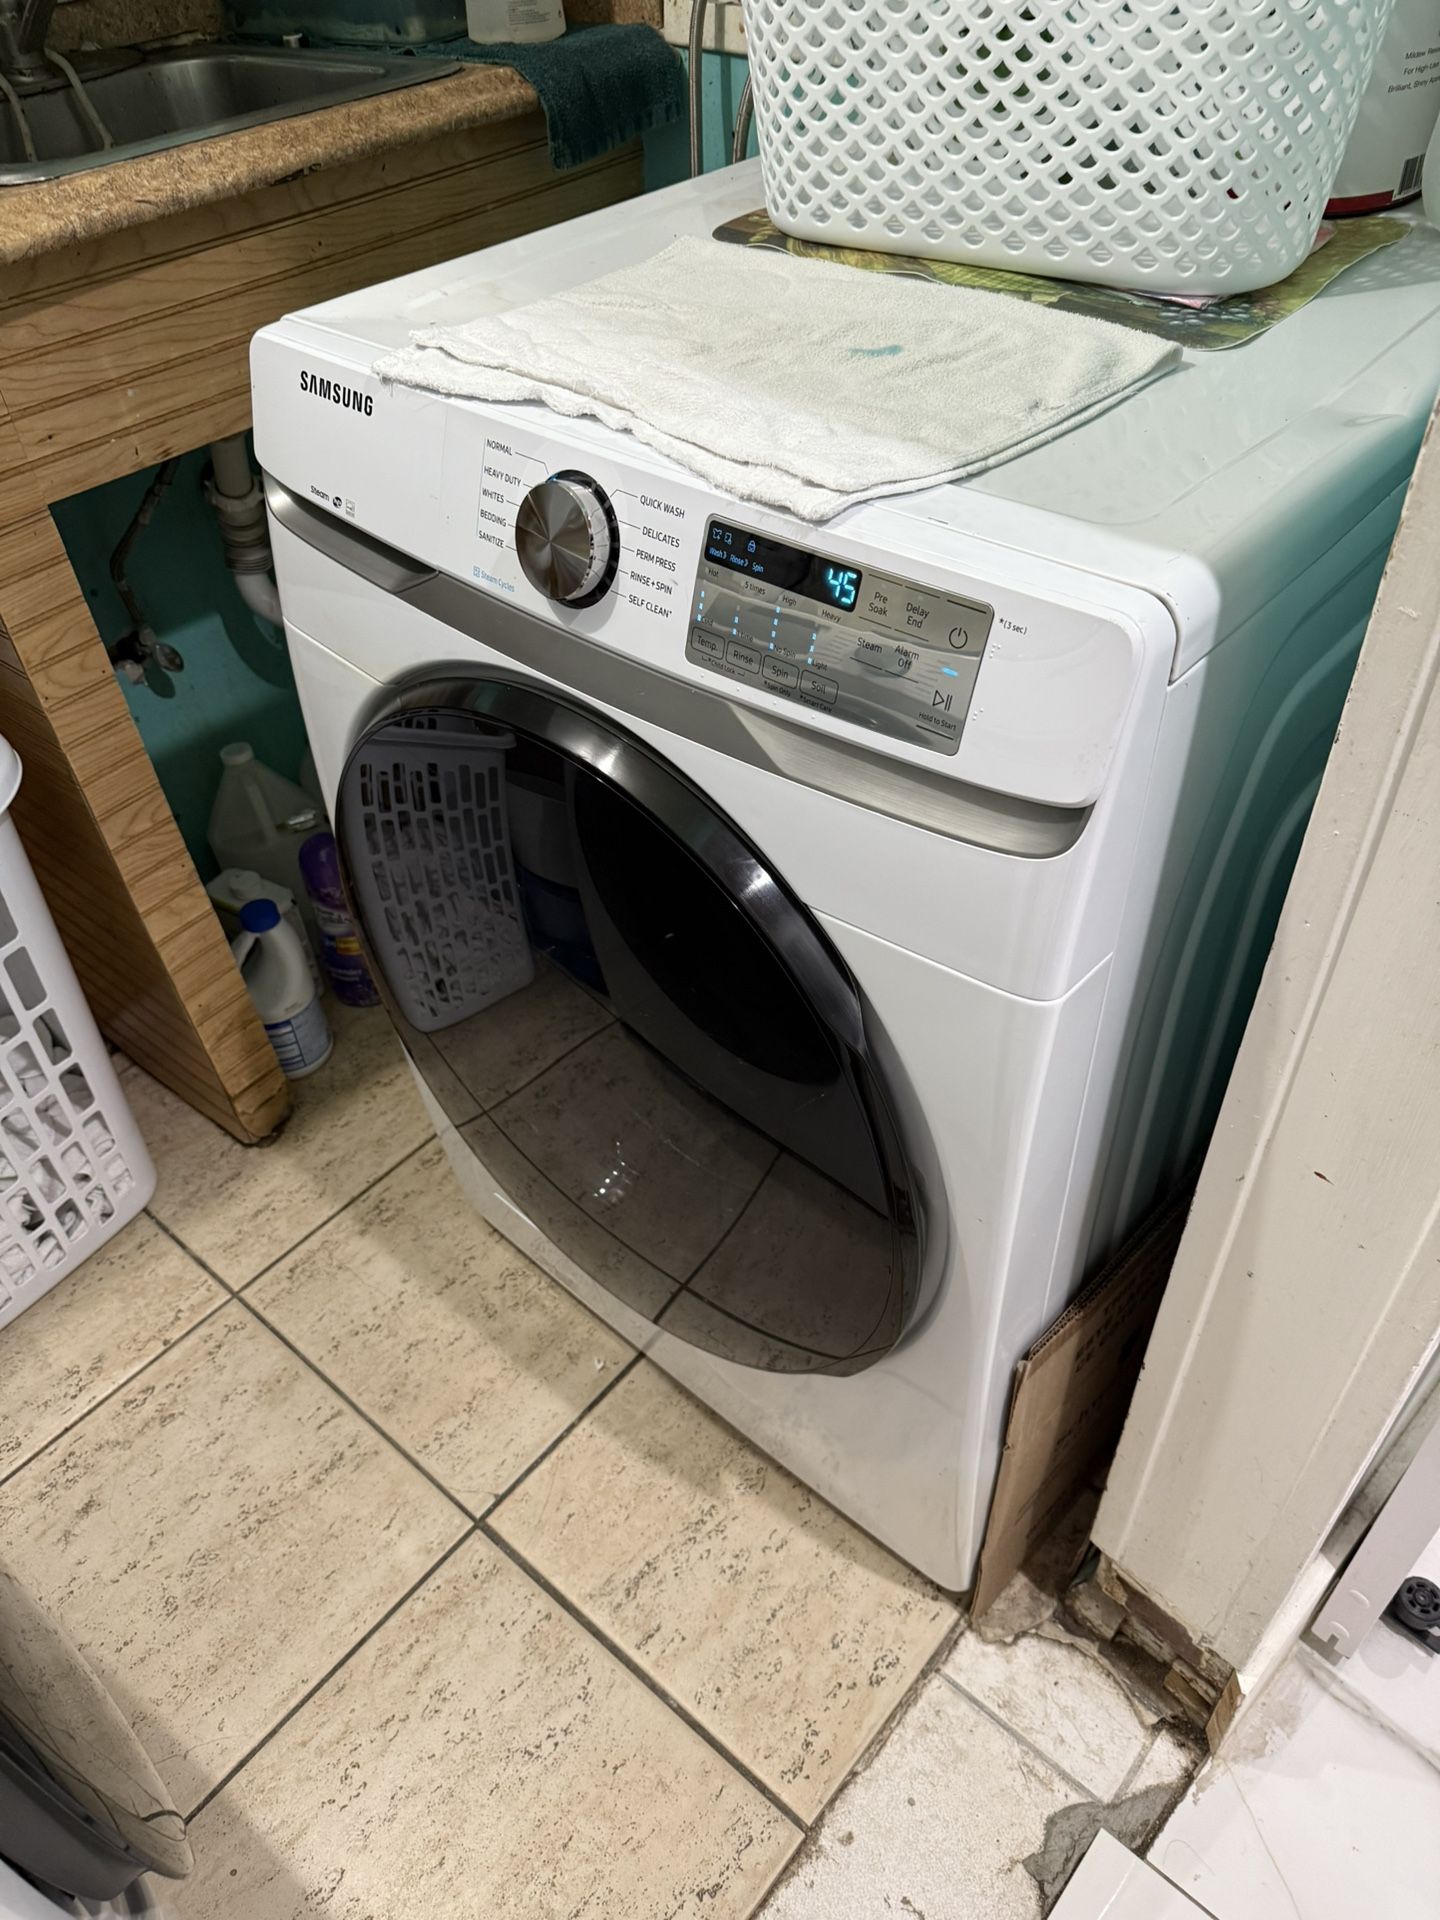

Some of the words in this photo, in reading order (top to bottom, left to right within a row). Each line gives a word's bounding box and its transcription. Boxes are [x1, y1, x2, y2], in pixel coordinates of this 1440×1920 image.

[300, 370, 373, 416] SAMSUNG
[487, 439, 512, 456] NORMAL
[483, 465, 504, 481] HEAVY
[504, 473, 521, 488] DUTY
[310, 484, 330, 502] Steam
[481, 488, 504, 504] WHITES
[640, 494, 662, 511] QUICK
[663, 502, 685, 519] WASH
[480, 509, 506, 528] BEDDING
[478, 530, 504, 549] SANITIZE
[642, 526, 680, 548] DELICATES
[636, 548, 655, 564] PERM
[655, 556, 676, 572] PRESS
[481, 570, 498, 585] Steam
[708, 568, 719, 577] Hot
[744, 581, 749, 589] 5
[749, 582, 766, 596] times
[828, 568, 857, 604] 45
[628, 594, 645, 607] SELF
[782, 595, 797, 607] High
[874, 591, 889, 604] Pre
[821, 609, 841, 624] Heavy
[868, 602, 889, 616] Soak
[906, 602, 930, 620] Delay
[906, 615, 923, 629] End
[1012, 624, 1027, 636] sec)
[697, 635, 718, 651] Temp.
[857, 637, 883, 654] Steam
[733, 649, 754, 666] Rinse
[895, 645, 920, 661] Alarm
[771, 664, 789, 679] Spin
[897, 657, 913, 671] Off
[779, 687, 791, 698] Only
[811, 680, 827, 695] Soil
[918, 711, 934, 722] Hold
[934, 717, 941, 725] to
[941, 719, 957, 732] Start
